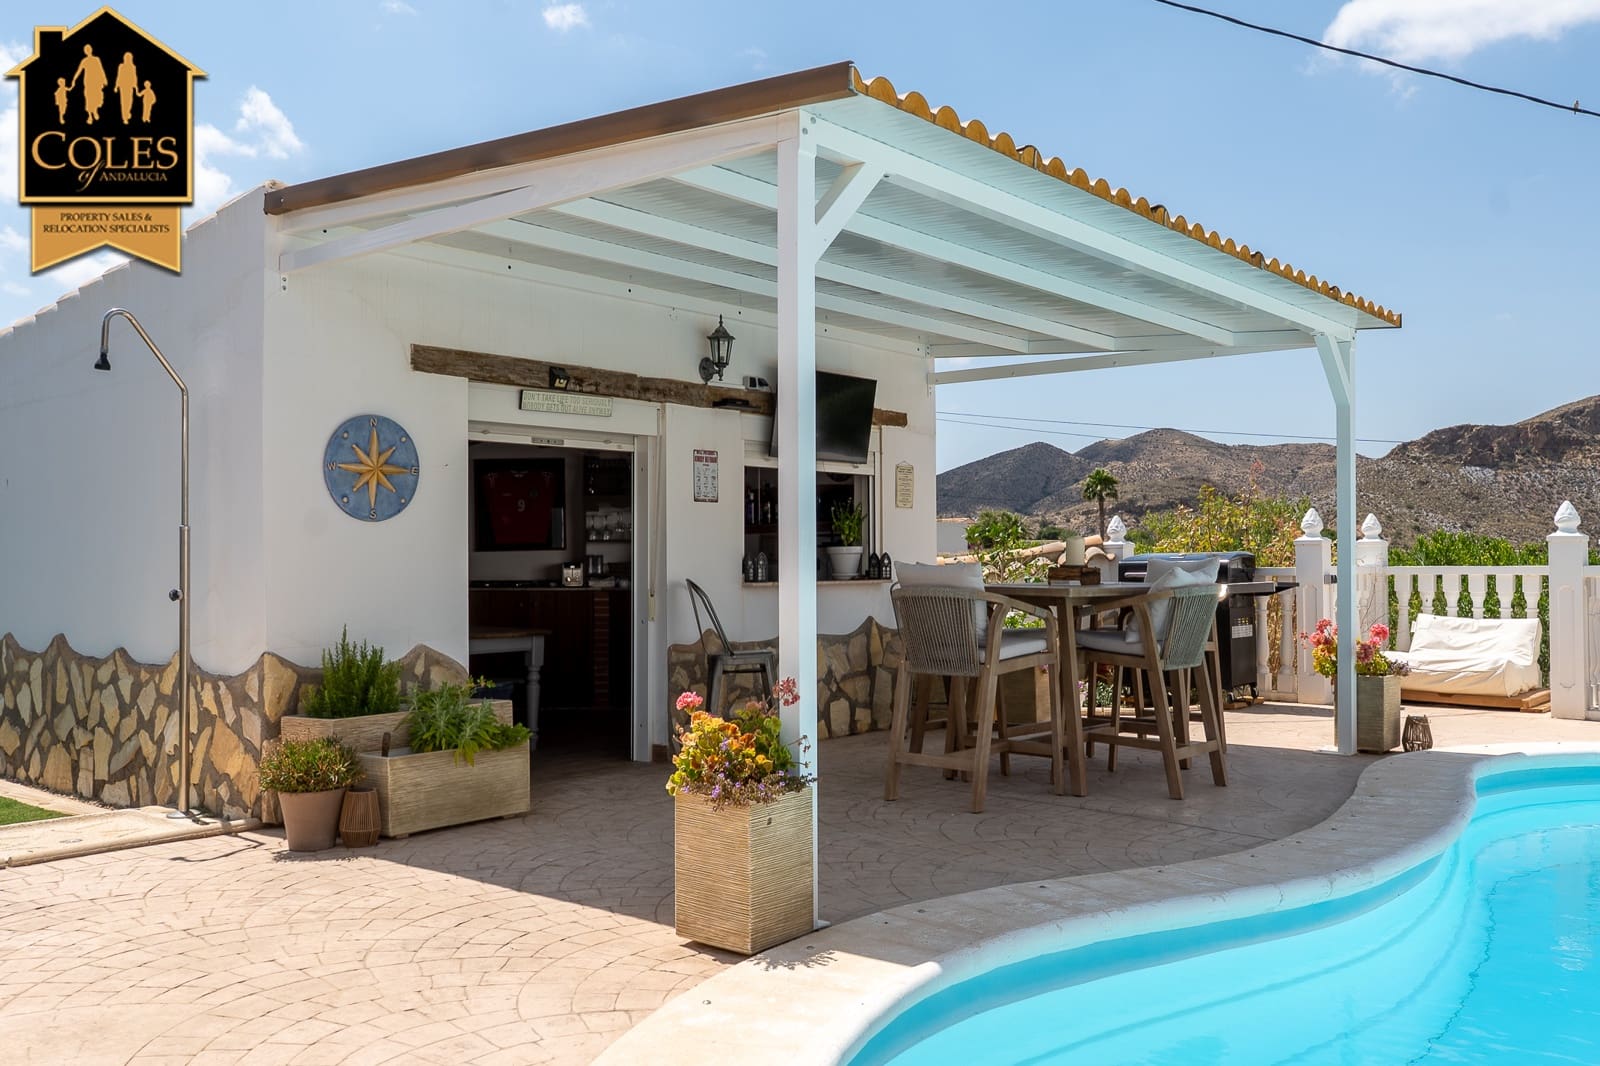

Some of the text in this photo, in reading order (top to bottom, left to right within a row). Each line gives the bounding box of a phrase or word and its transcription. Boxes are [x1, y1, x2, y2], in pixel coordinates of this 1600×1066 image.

[370, 418, 377, 426] N
[328, 462, 336, 471] W
[411, 467, 419, 476] E
[517, 499, 525, 512] 9
[369, 508, 377, 519] S
